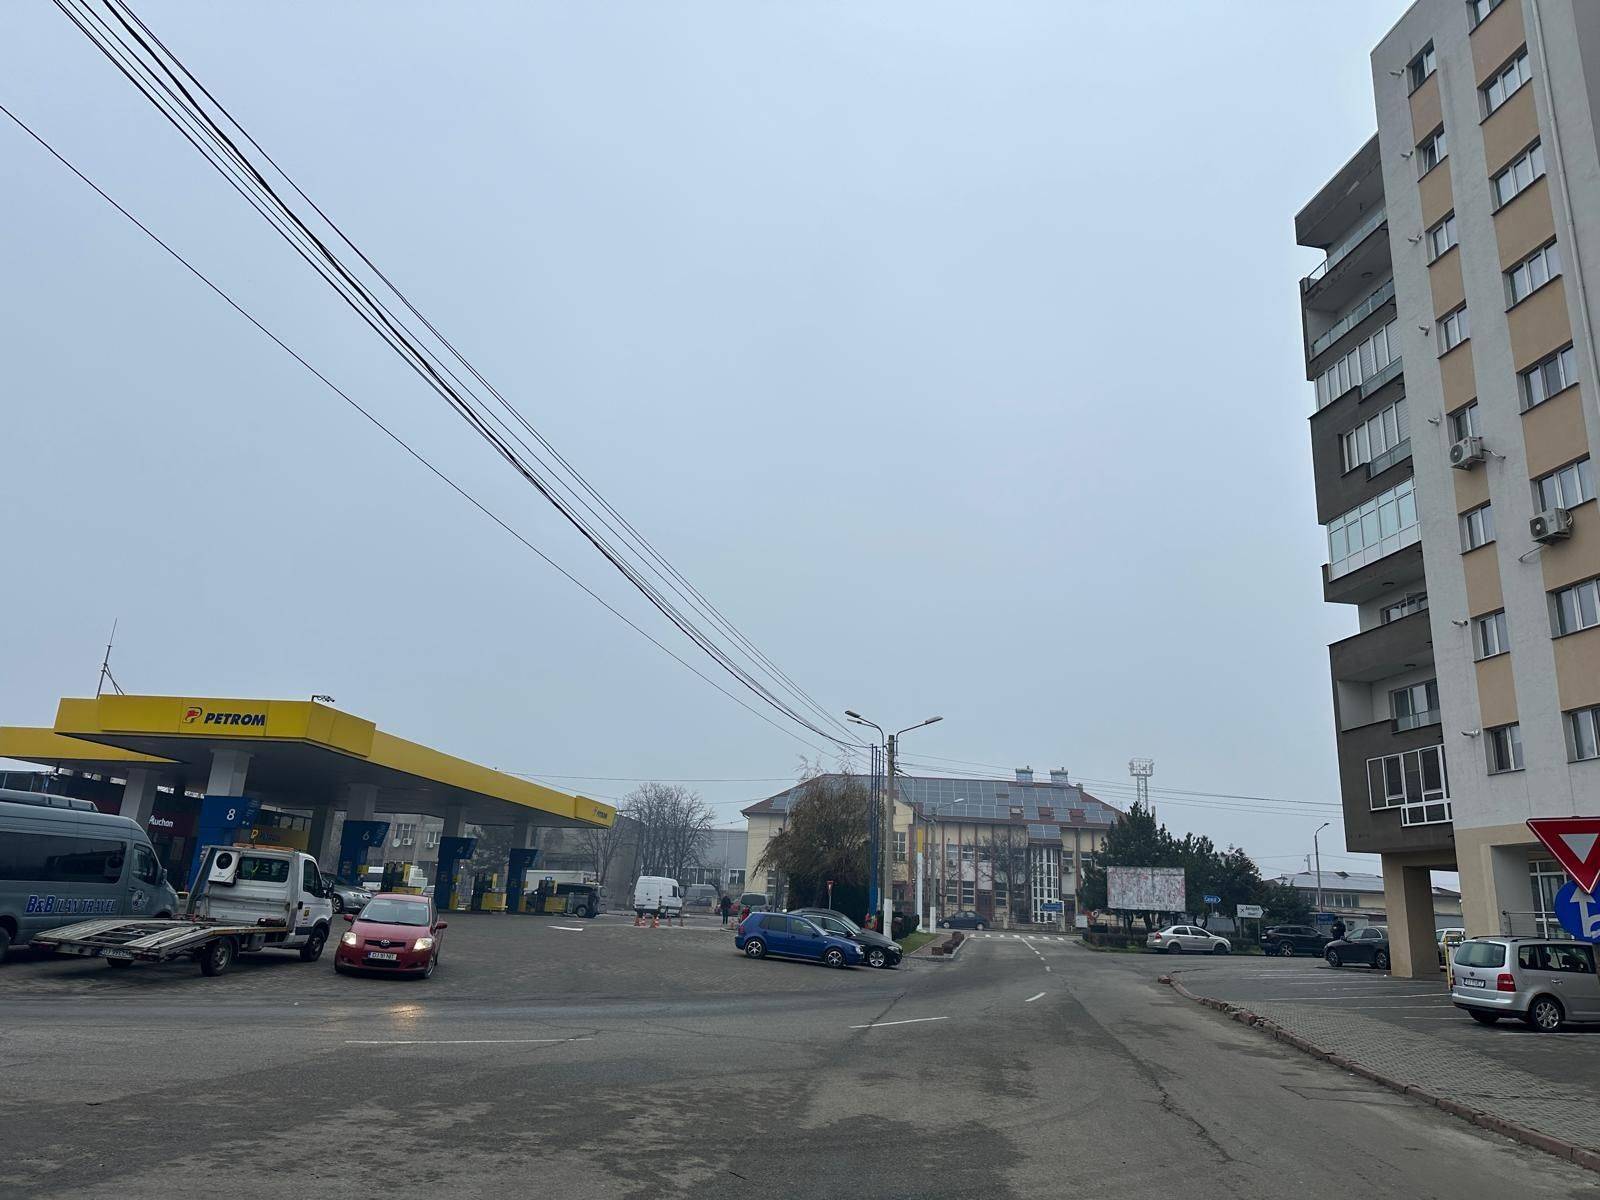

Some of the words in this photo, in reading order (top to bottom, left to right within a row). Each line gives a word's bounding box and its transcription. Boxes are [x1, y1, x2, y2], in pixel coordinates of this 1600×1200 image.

[203, 712, 266, 726] PETROM
[148, 814, 174, 828] Auchan
[226, 808, 236, 821] 8
[362, 830, 370, 841] 6
[24, 894, 56, 914] B&B
[81, 898, 117, 914] TRAVEL
